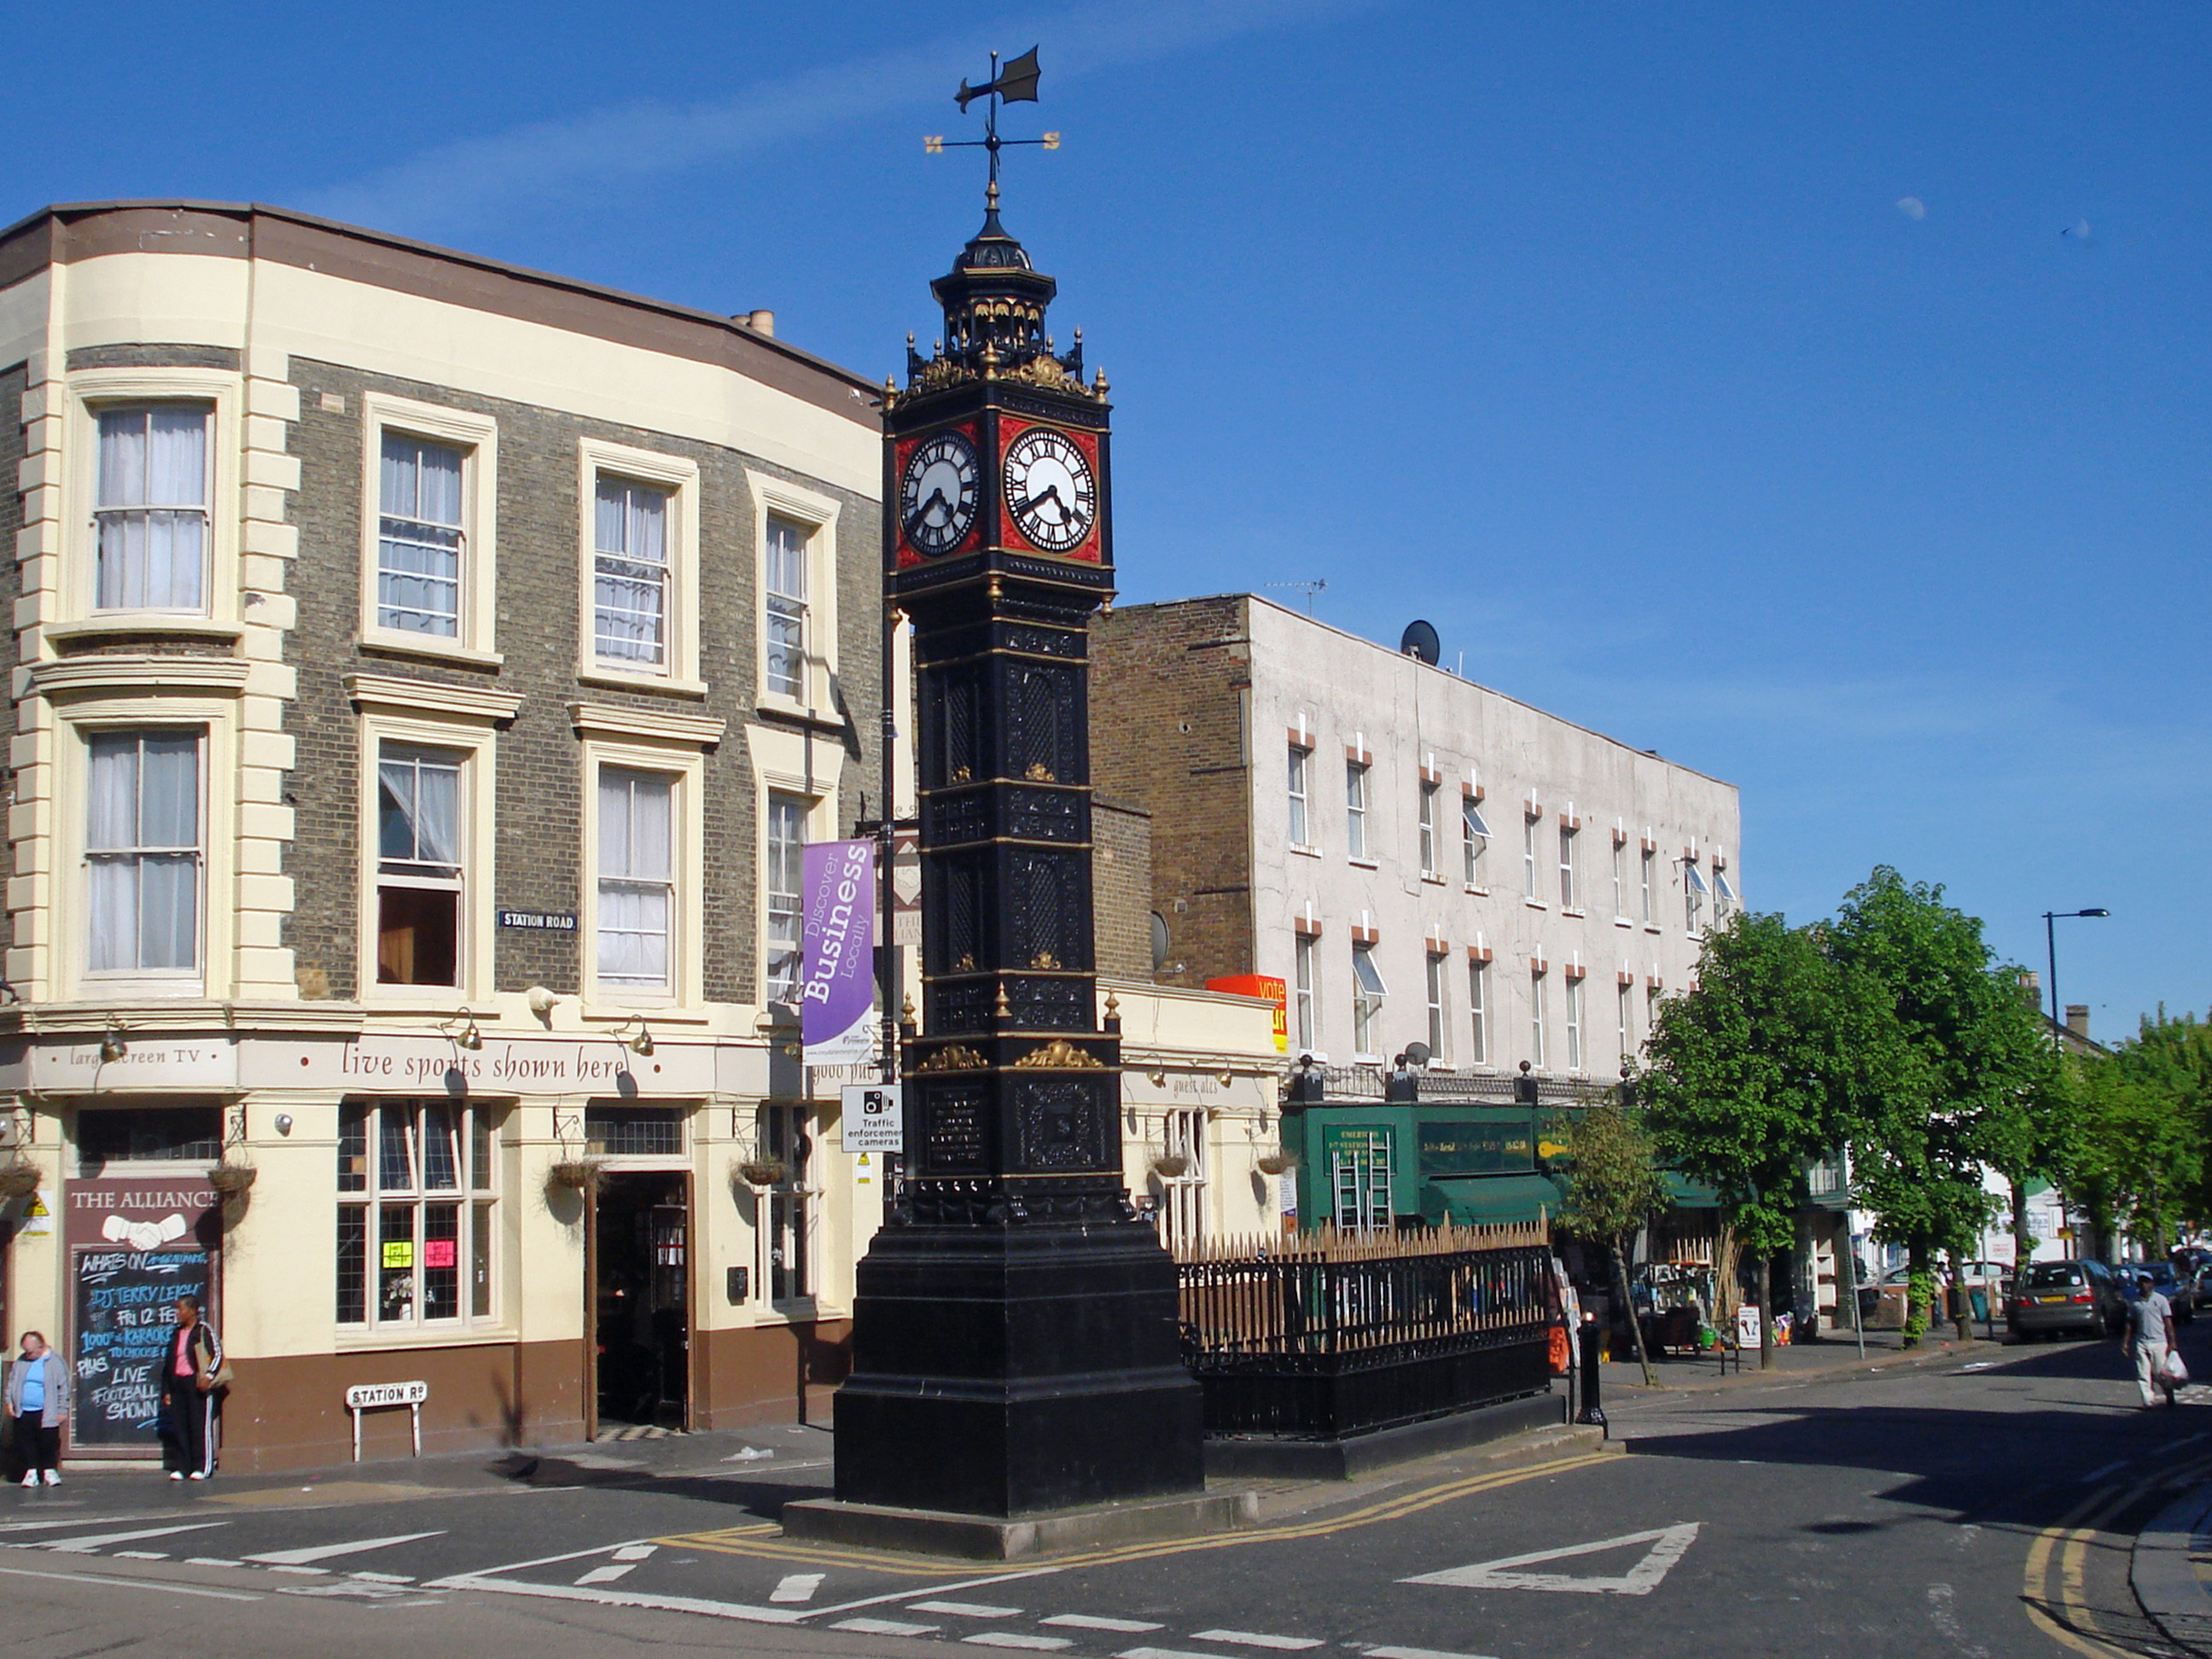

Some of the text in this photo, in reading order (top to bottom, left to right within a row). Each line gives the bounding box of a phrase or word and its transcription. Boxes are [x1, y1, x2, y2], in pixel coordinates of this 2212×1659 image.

[805, 852, 840, 939] Discover
[504, 912, 544, 928] STATION
[804, 843, 869, 1005] Business
[840, 915, 870, 981] Locally
[1258, 980, 1285, 1003] vote
[70, 1047, 201, 1070] larg creen TV
[342, 1039, 626, 1085] live sports shown here
[1173, 1080, 1198, 1099] guest
[863, 1119, 894, 1127] Traffic
[71, 1191, 219, 1209] THE ALLIANCE
[128, 1251, 149, 1271] ON
[117, 1285, 158, 1304] TERRY
[117, 1309, 137, 1326] FRI
[140, 1308, 154, 1324] 12
[108, 1347, 122, 1359] TO
[123, 1346, 162, 1359] CHOOSE
[111, 1365, 152, 1385] LIVE
[91, 1384, 160, 1405] FOOTBALL
[352, 1388, 405, 1404] STATION
[106, 1399, 159, 1421] SHOWN
